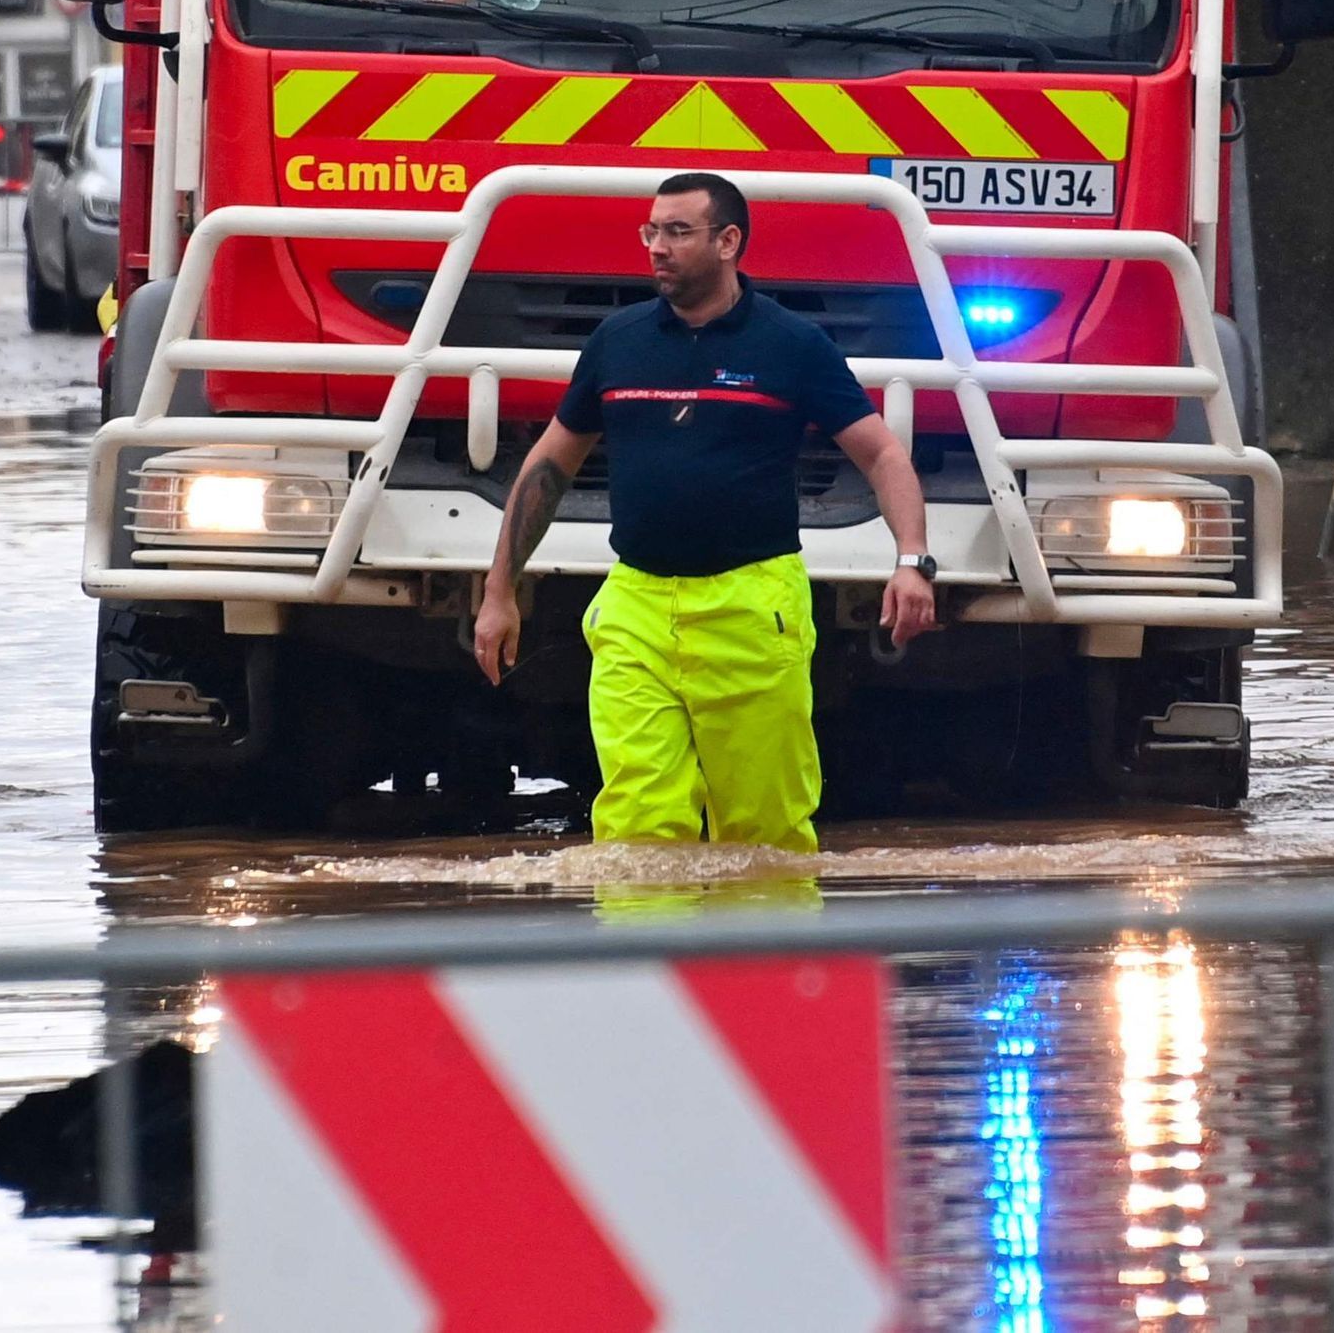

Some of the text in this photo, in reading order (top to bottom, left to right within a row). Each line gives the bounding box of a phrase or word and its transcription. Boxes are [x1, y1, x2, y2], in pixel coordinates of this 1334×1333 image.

[285, 155, 467, 193] Camiva
[904, 165, 1097, 207] 150 ASV34
